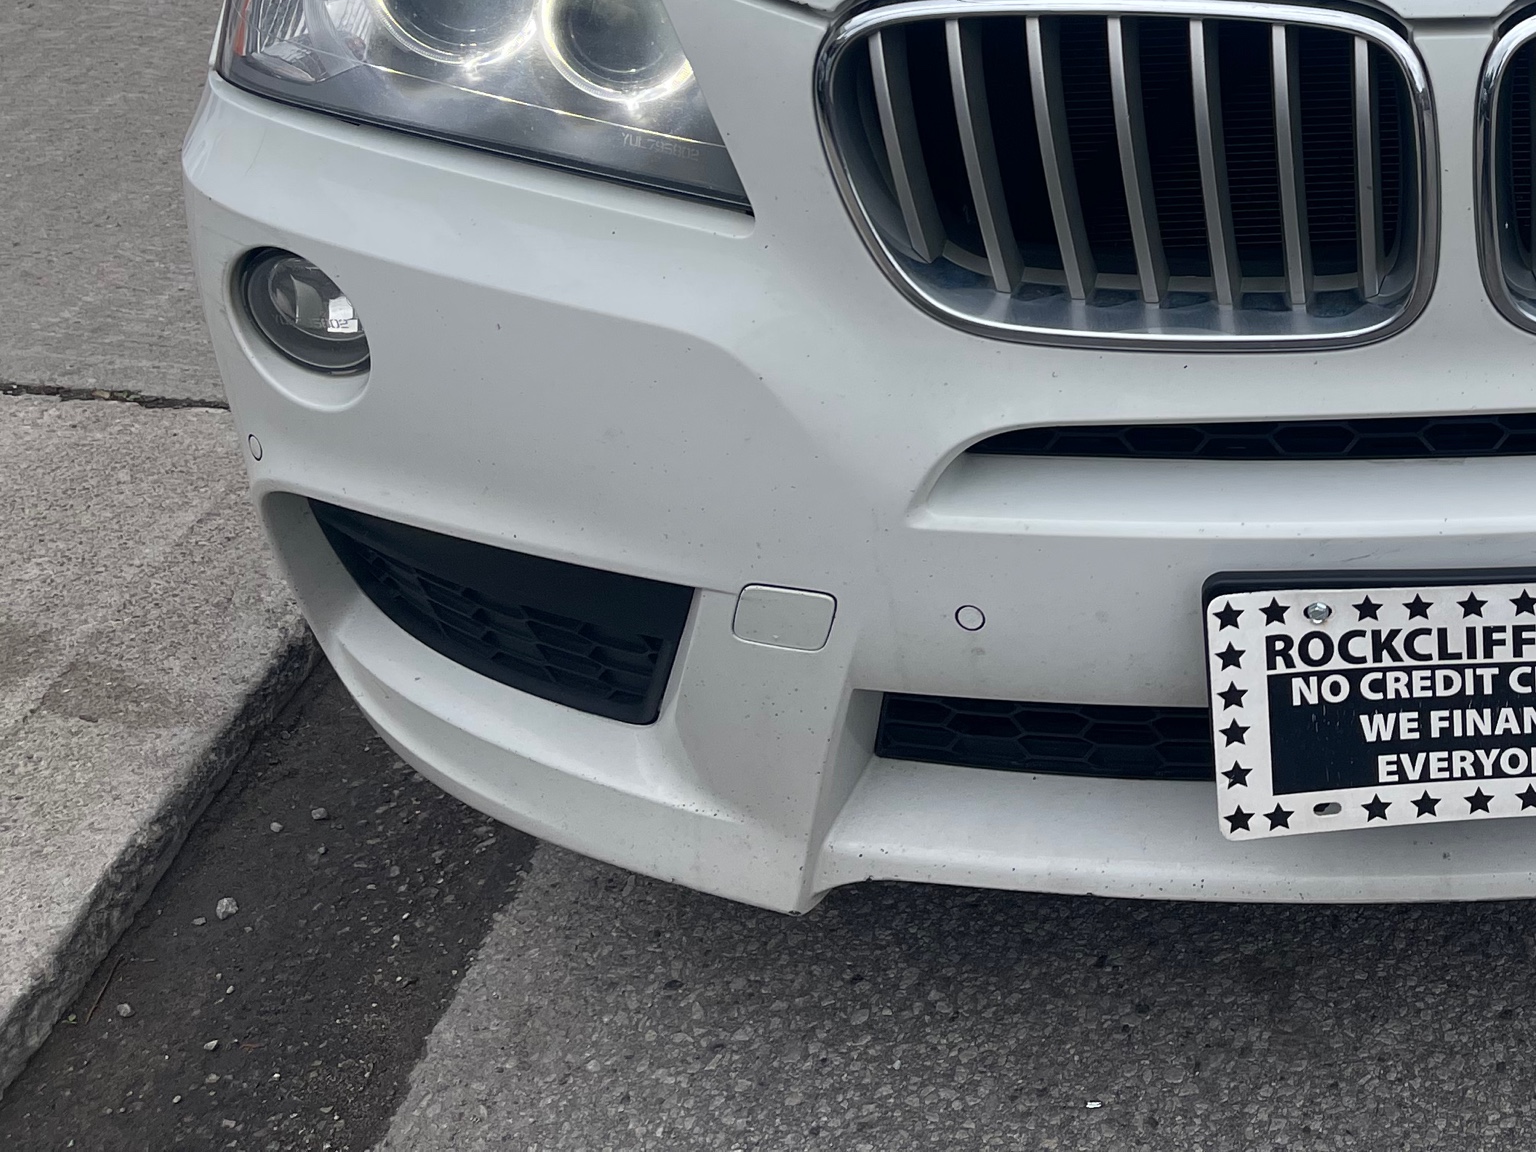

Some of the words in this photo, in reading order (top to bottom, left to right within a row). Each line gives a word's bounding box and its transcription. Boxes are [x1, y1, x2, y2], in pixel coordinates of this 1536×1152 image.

[1266, 624, 1536, 671] ROCKCLIFF
[1291, 676, 1351, 707] NO
[1359, 667, 1499, 700] CREDIT
[1359, 711, 1421, 743] WE
